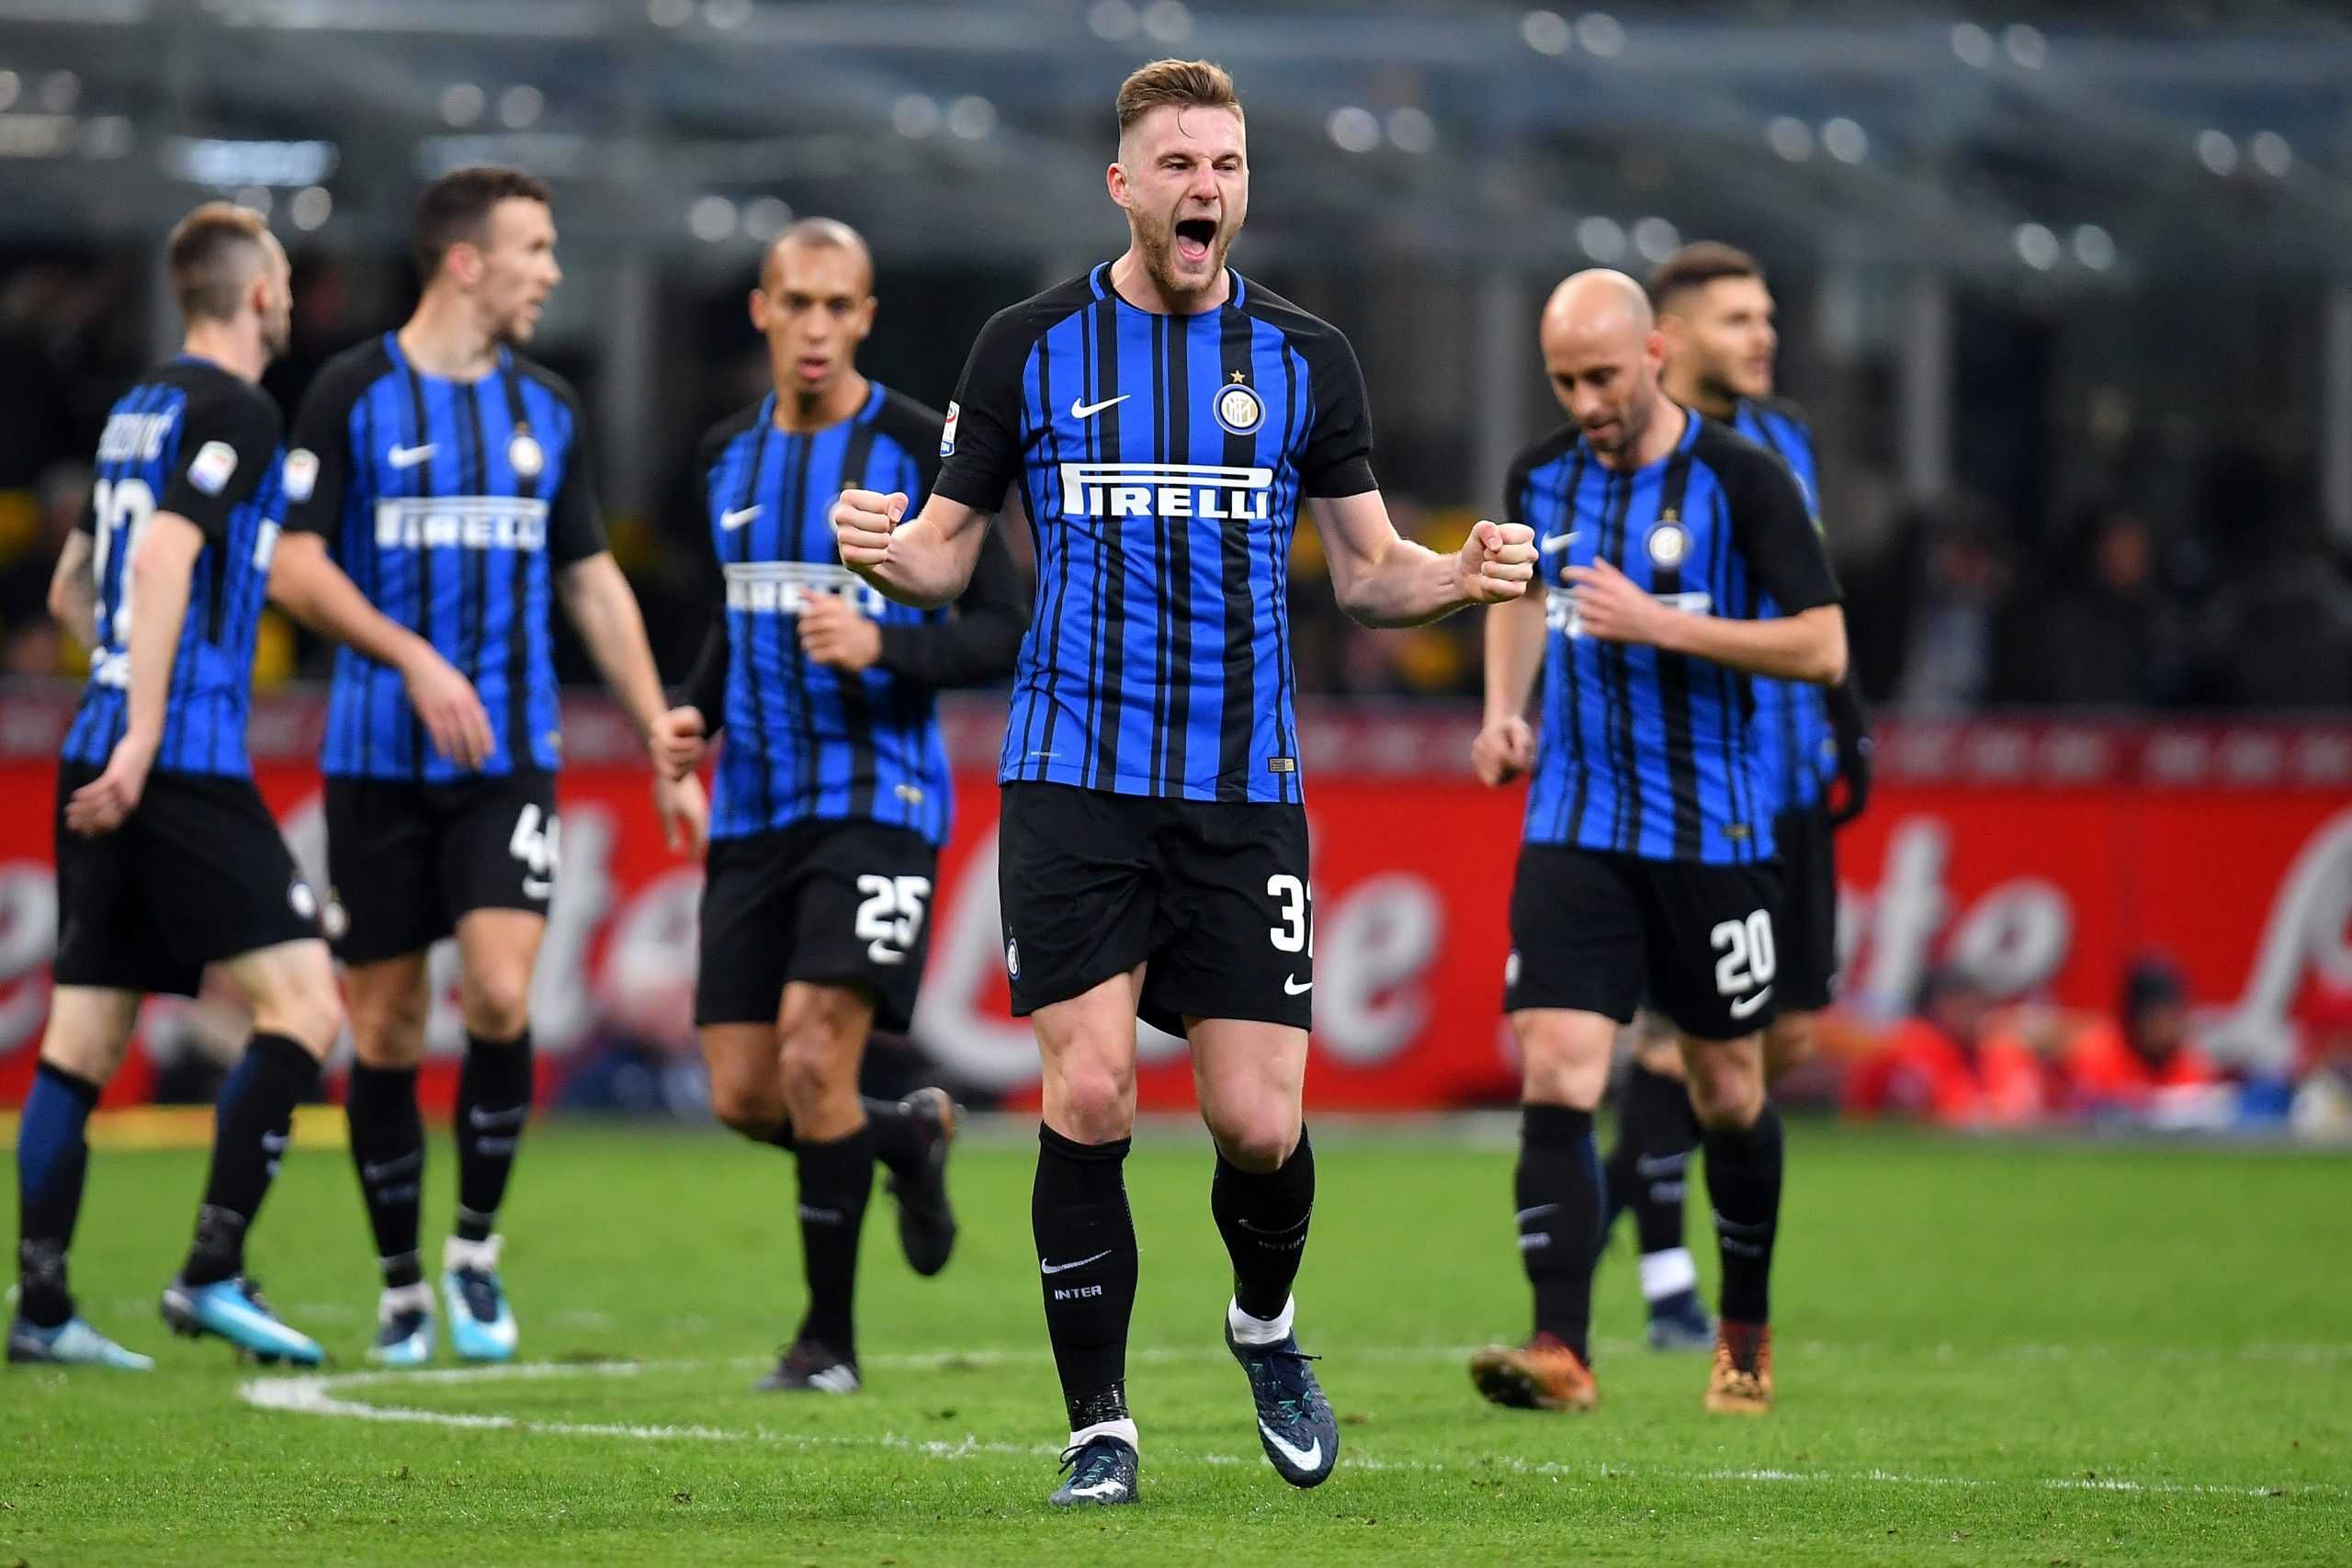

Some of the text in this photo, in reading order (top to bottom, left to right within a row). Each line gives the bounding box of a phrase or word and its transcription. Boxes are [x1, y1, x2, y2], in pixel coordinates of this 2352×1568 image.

[1060, 463, 1273, 520] PIRELLI
[854, 874, 932, 948] 25
[1267, 874, 1314, 959] 3
[1710, 908, 1777, 996] 20
[1054, 1284, 1102, 1301] INTER
